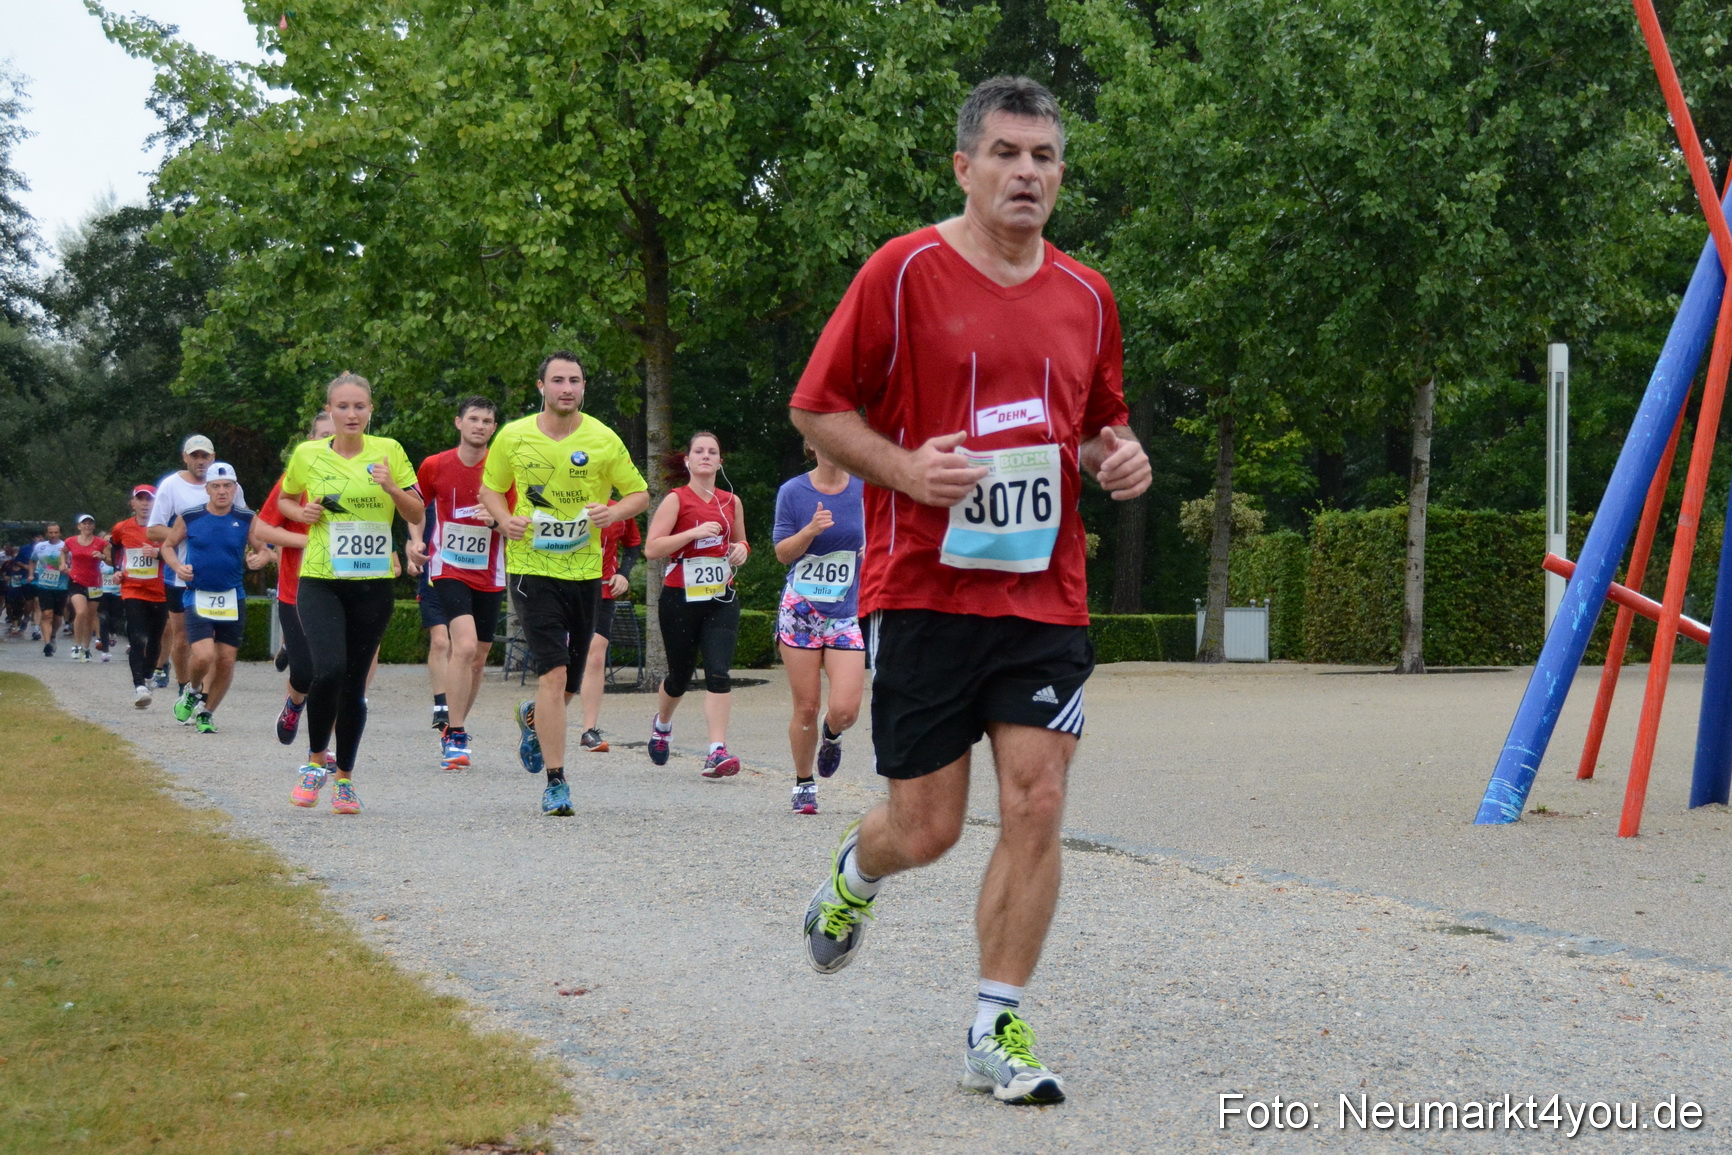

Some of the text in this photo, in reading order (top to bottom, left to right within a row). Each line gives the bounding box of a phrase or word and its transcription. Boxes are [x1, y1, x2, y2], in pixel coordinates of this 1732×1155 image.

[997, 408, 1028, 424] DEHN
[999, 450, 1050, 469] BOCK
[566, 489, 583, 497] NEXT
[964, 476, 1053, 528] 3076
[539, 518, 588, 539] 2872
[336, 534, 388, 556] 2892
[446, 533, 487, 553] 2126
[132, 555, 153, 568] 280
[353, 560, 371, 570] Nina
[454, 554, 476, 564] Tobias
[694, 565, 724, 584] 230
[800, 561, 850, 583] 2469
[812, 586, 832, 595] Julia
[208, 595, 226, 608] 79
[1032, 694, 1060, 705] adidas
